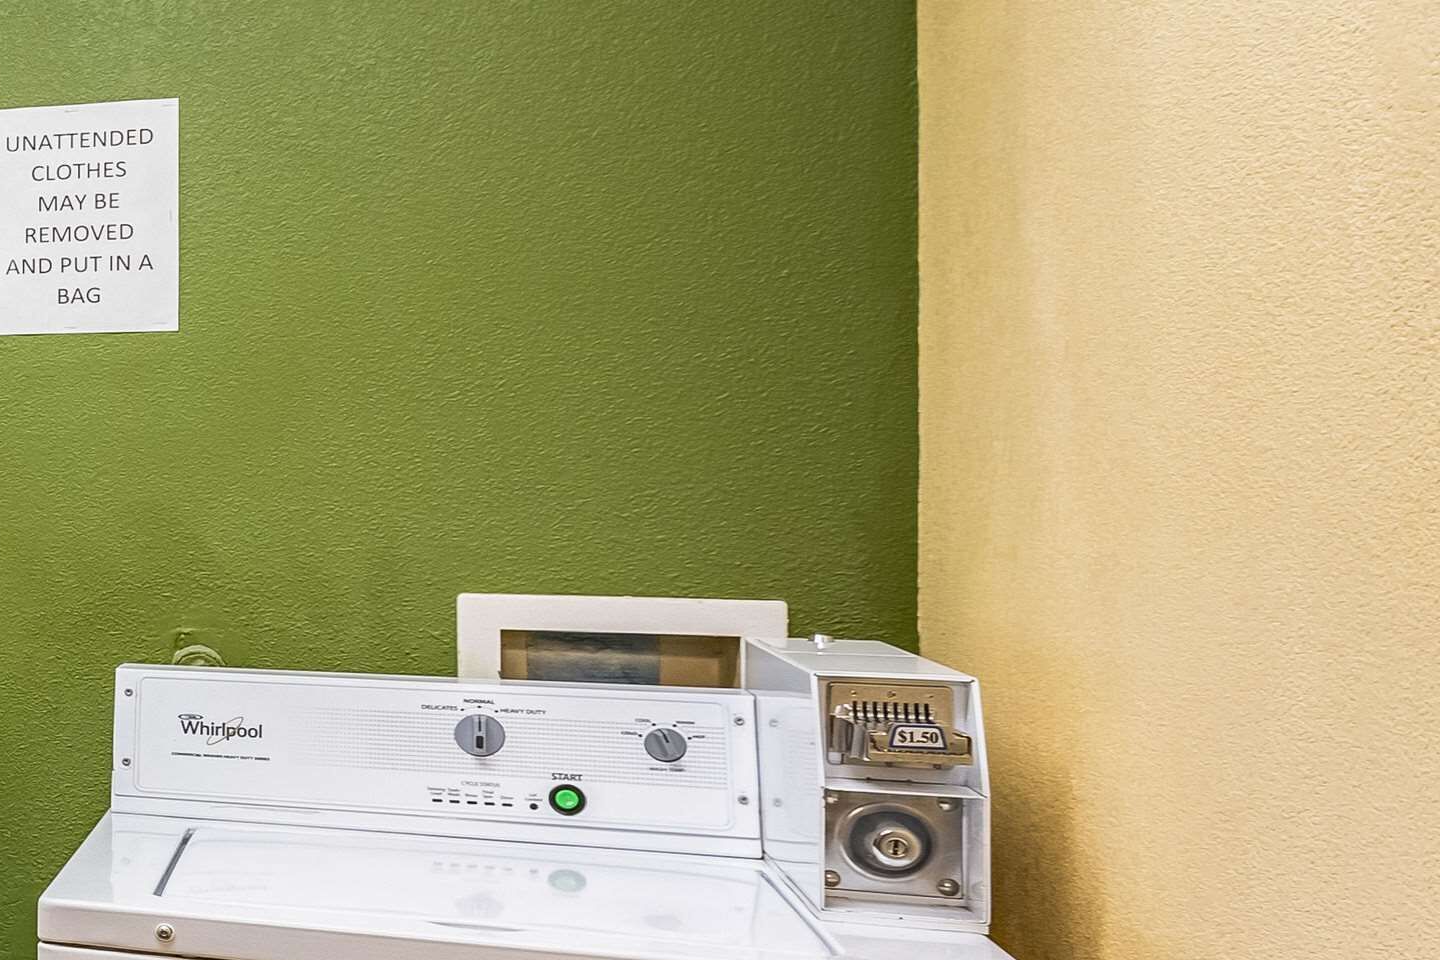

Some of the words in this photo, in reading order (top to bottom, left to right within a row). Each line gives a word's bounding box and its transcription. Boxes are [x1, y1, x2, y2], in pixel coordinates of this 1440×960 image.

[6, 128, 154, 153] UNATTENDED
[31, 161, 127, 182] CLOTHES
[38, 193, 87, 212] MAY
[94, 192, 120, 210] BE
[25, 224, 134, 244] REMOVED
[6, 257, 53, 275] AND
[60, 256, 102, 273] PUT
[109, 254, 131, 271] IN
[138, 254, 154, 271] A
[57, 287, 101, 304] BAG
[180, 720, 263, 741] Whirlpool
[897, 729, 940, 745] $1.50
[551, 772, 584, 782] START
